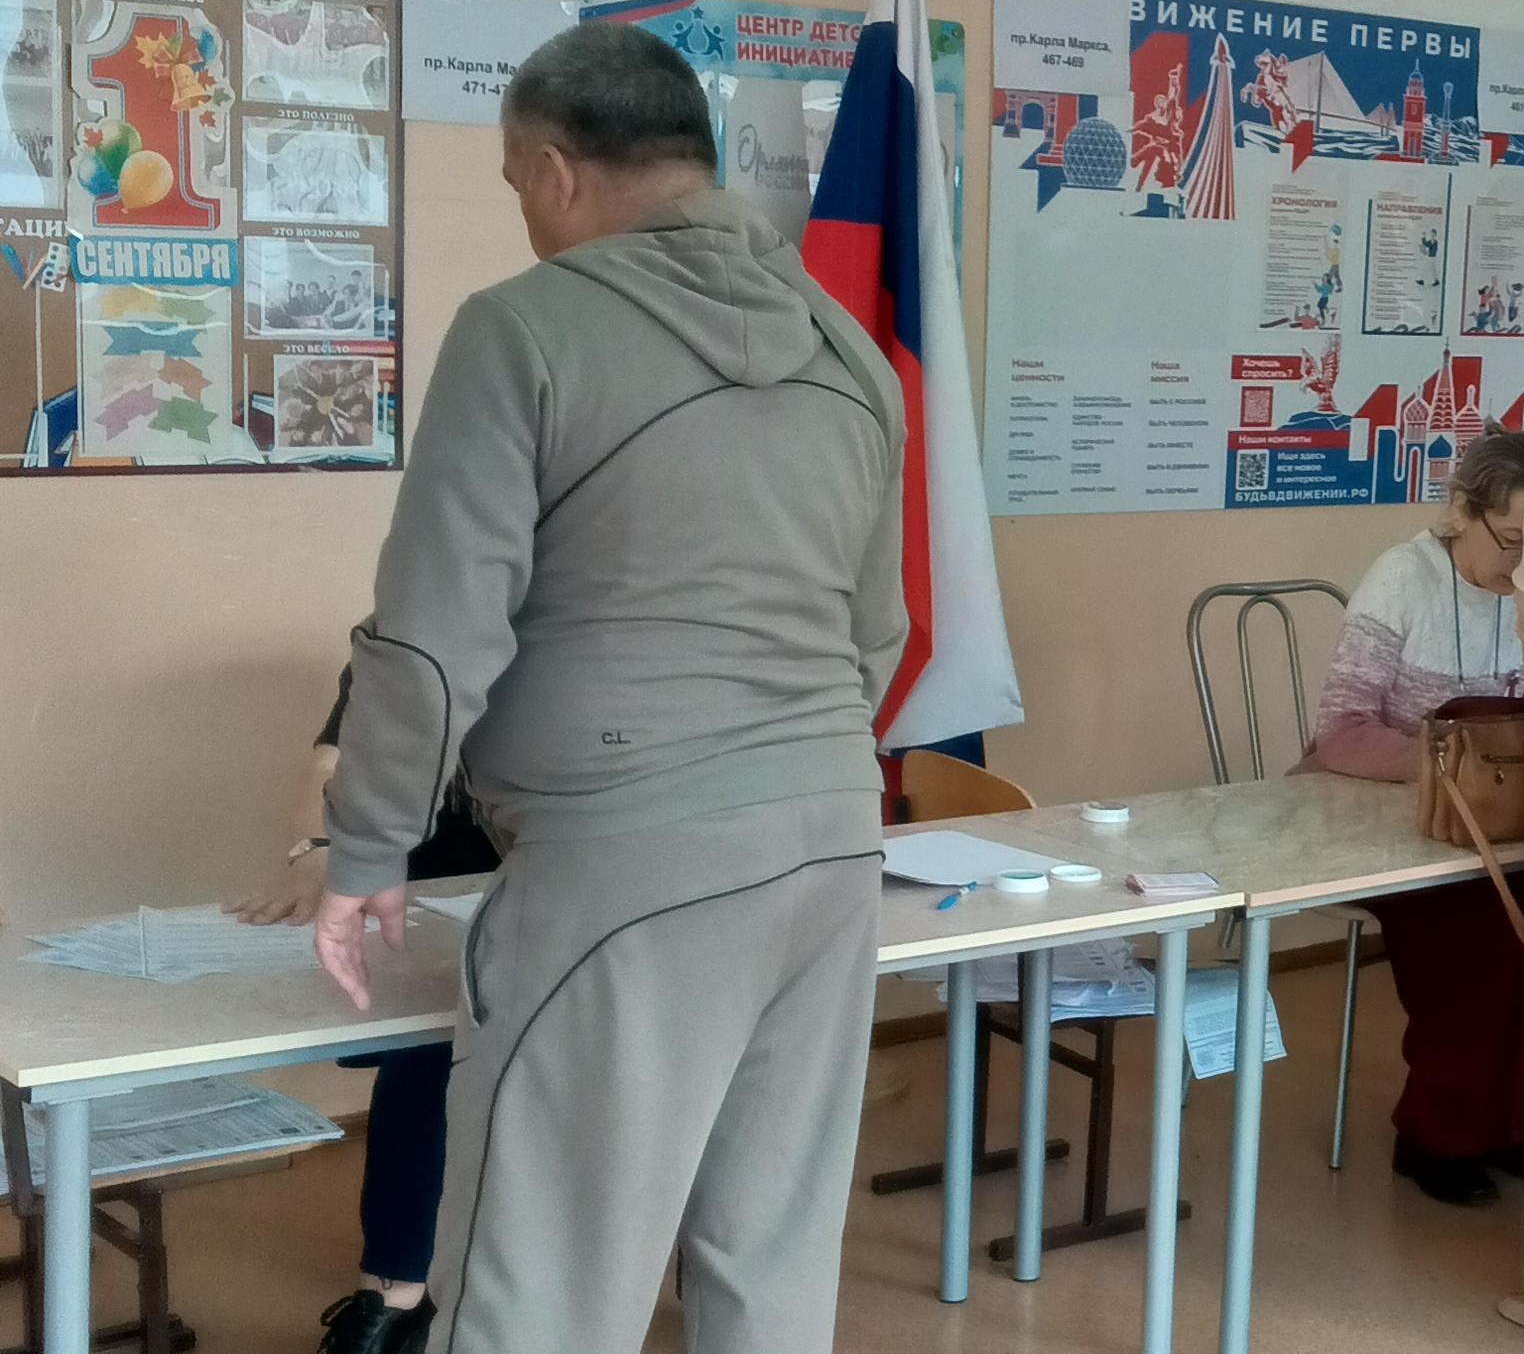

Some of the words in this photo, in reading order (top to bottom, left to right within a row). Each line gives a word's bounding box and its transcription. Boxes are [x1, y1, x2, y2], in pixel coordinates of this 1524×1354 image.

[736, 14, 804, 37] ЦЕНТР
[809, 21, 862, 43] ДЕТС
[1350, 24, 1471, 59] ПЕРВЫ
[736, 42, 855, 69] ИНИЦИАТИВ
[424, 57, 493, 75] пр.Карла
[278, 109, 299, 118] ЭТО
[1271, 196, 1338, 209] ХРОНОЛОГИЯ
[1376, 203, 1443, 216] НАПРАВЛЕНИЯ
[272, 227, 293, 237] ЭТО
[296, 228, 360, 239] ВОЗМОЖНО
[76, 240, 232, 280] СЕНТЯБРЯ
[1242, 369, 1293, 379] спросить?
[1238, 435, 1266, 444] Наши
[1235, 488, 1369, 503] БУДЬВДВИЖЕНИИ.РФ
